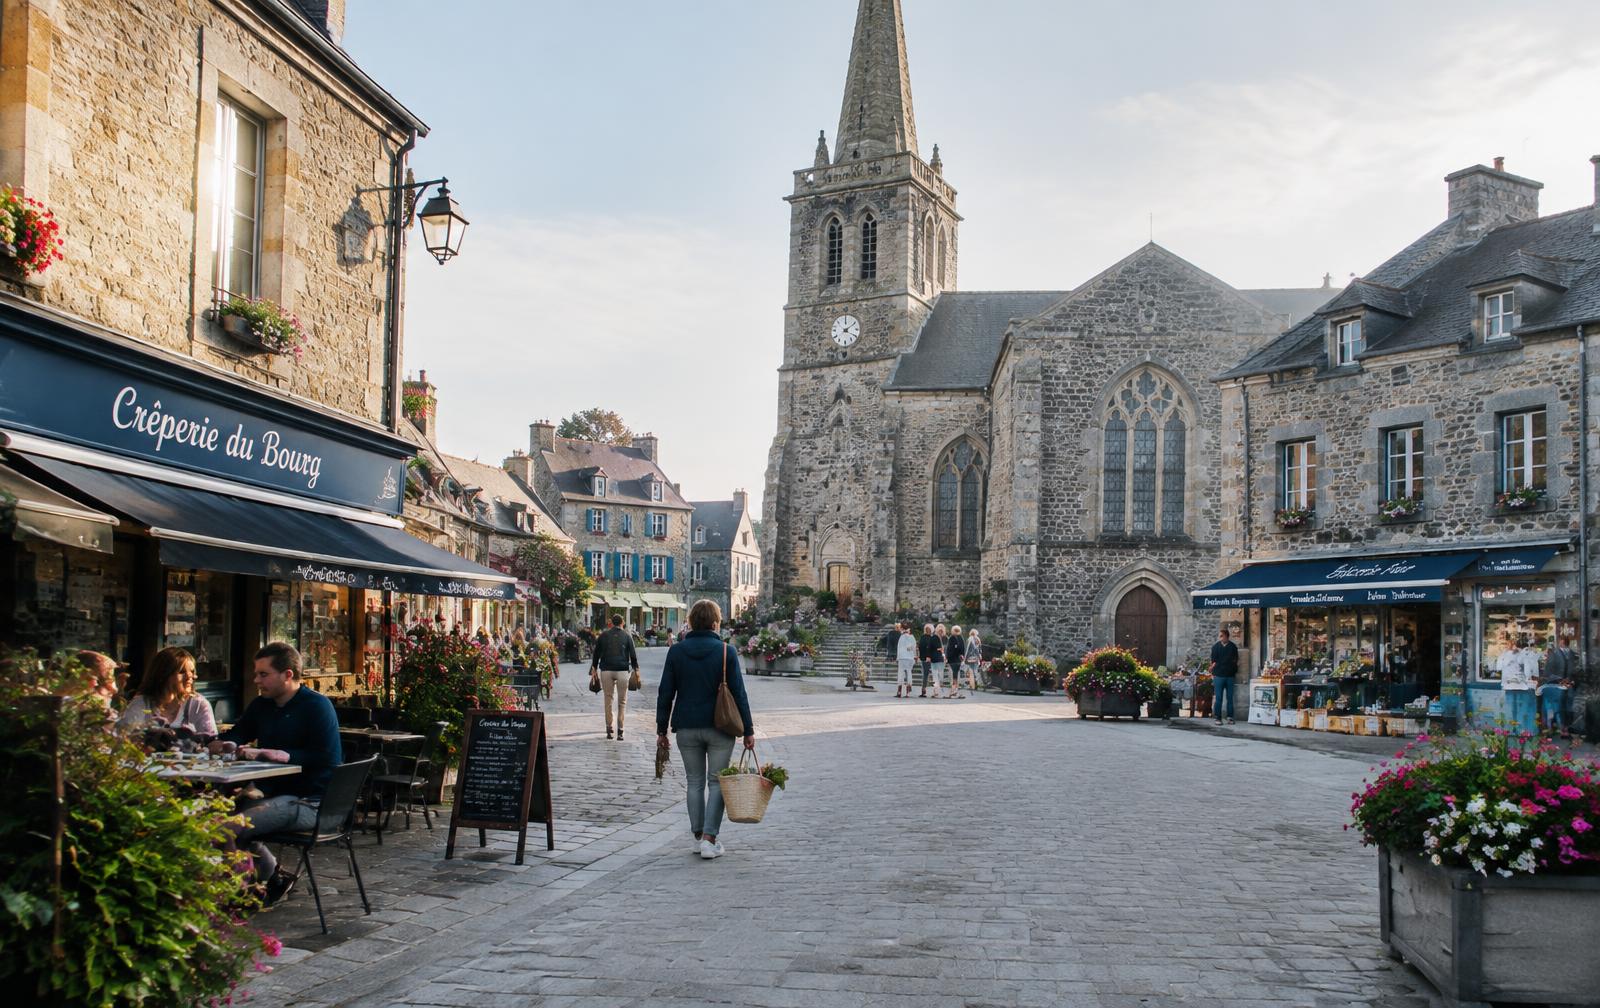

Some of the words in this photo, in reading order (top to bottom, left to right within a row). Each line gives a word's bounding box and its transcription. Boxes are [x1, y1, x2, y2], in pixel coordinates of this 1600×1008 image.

[112, 386, 219, 451] Crêperie
[226, 424, 253, 461] du
[261, 431, 322, 489] Bourg
